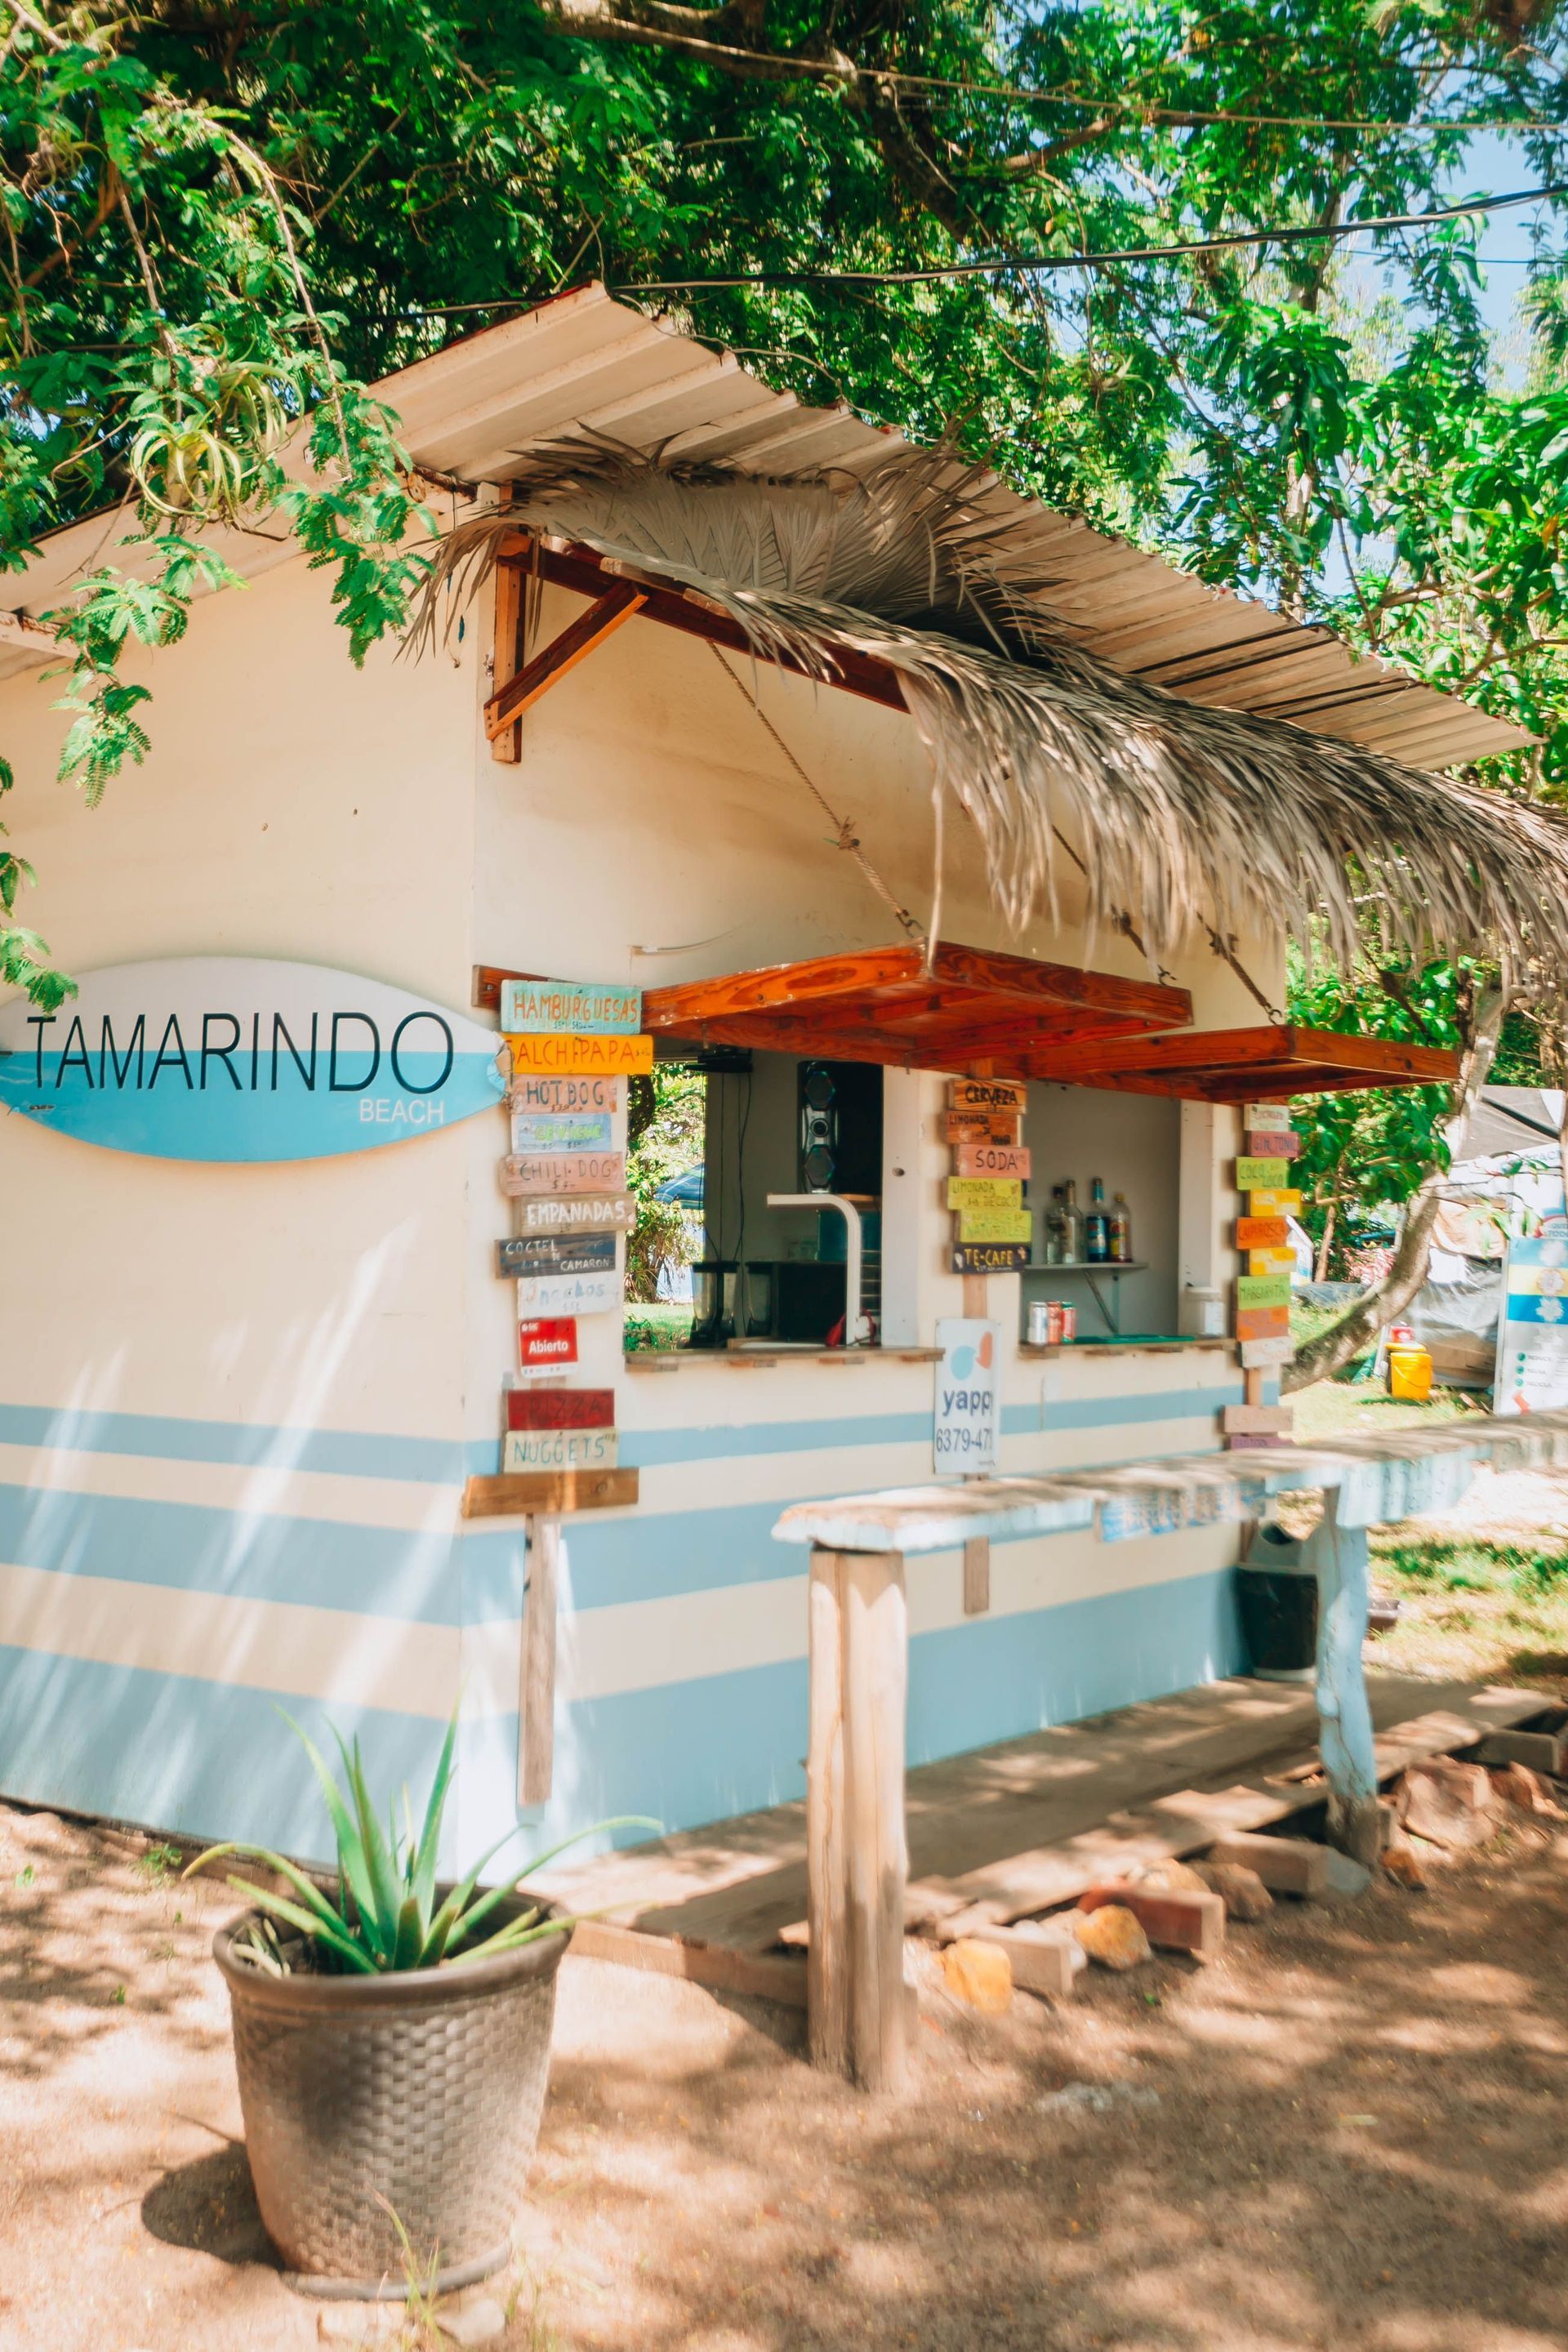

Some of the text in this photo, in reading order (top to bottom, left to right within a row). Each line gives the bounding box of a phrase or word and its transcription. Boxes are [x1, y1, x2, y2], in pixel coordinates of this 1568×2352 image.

[513, 991, 639, 1023] HAMBURGUESAS
[27, 1011, 454, 1094] TAMARINDO
[526, 1080, 563, 1105] HOT
[965, 1085, 1018, 1106] CERVEZA
[359, 1098, 445, 1124] BEACH
[519, 1159, 612, 1181] CHILI DOG
[975, 1150, 1018, 1171] SODA
[527, 1200, 626, 1227] EMPANADAS
[505, 1239, 559, 1255] COCTEL
[551, 1252, 561, 1262] DE
[964, 1248, 1013, 1267] TE-CAFE
[559, 1258, 610, 1272] CAMARON
[528, 1339, 569, 1355] Abierto
[514, 1436, 605, 1464] NUGGETS
